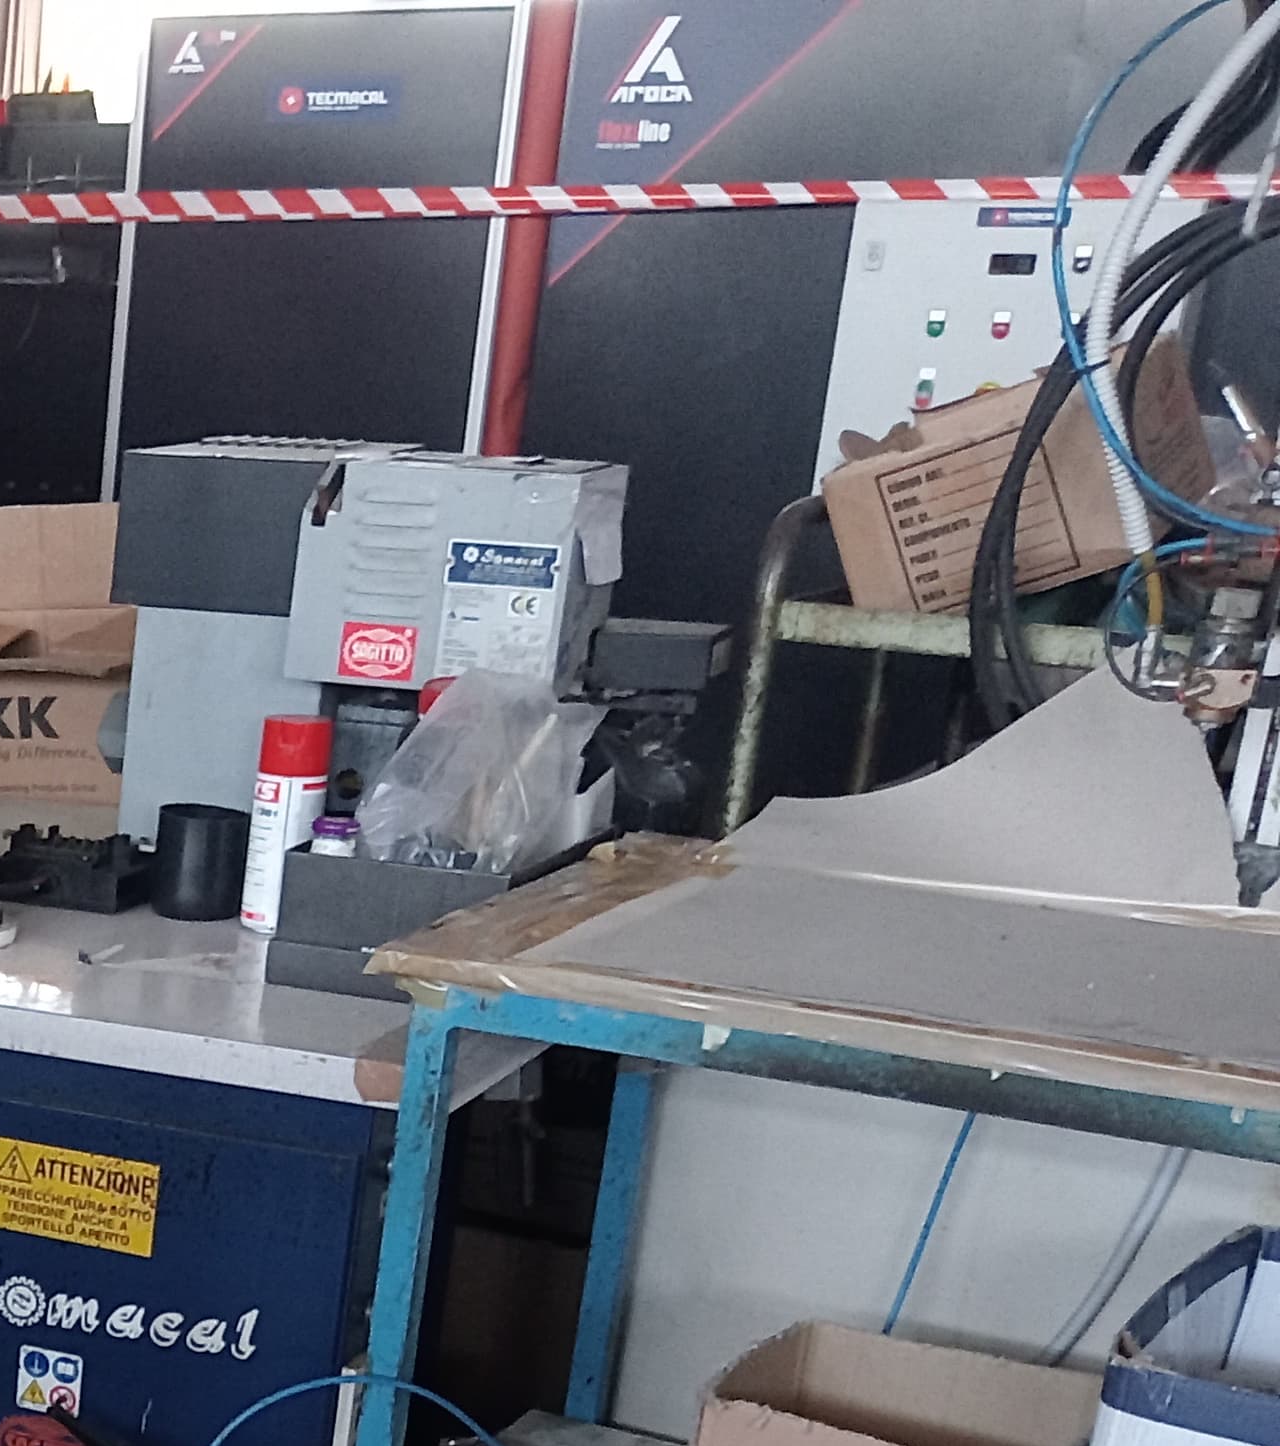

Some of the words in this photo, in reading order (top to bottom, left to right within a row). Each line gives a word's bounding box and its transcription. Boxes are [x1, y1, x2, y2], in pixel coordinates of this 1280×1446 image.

[34, 1157, 155, 1204] ATTENZIONE
[1, 1211, 75, 1235] SPORTELLO
[79, 1227, 131, 1247] APERTO
[8, 1199, 67, 1221] TENSIONE
[71, 1212, 115, 1230] ANCHE
[119, 1220, 128, 1231] A
